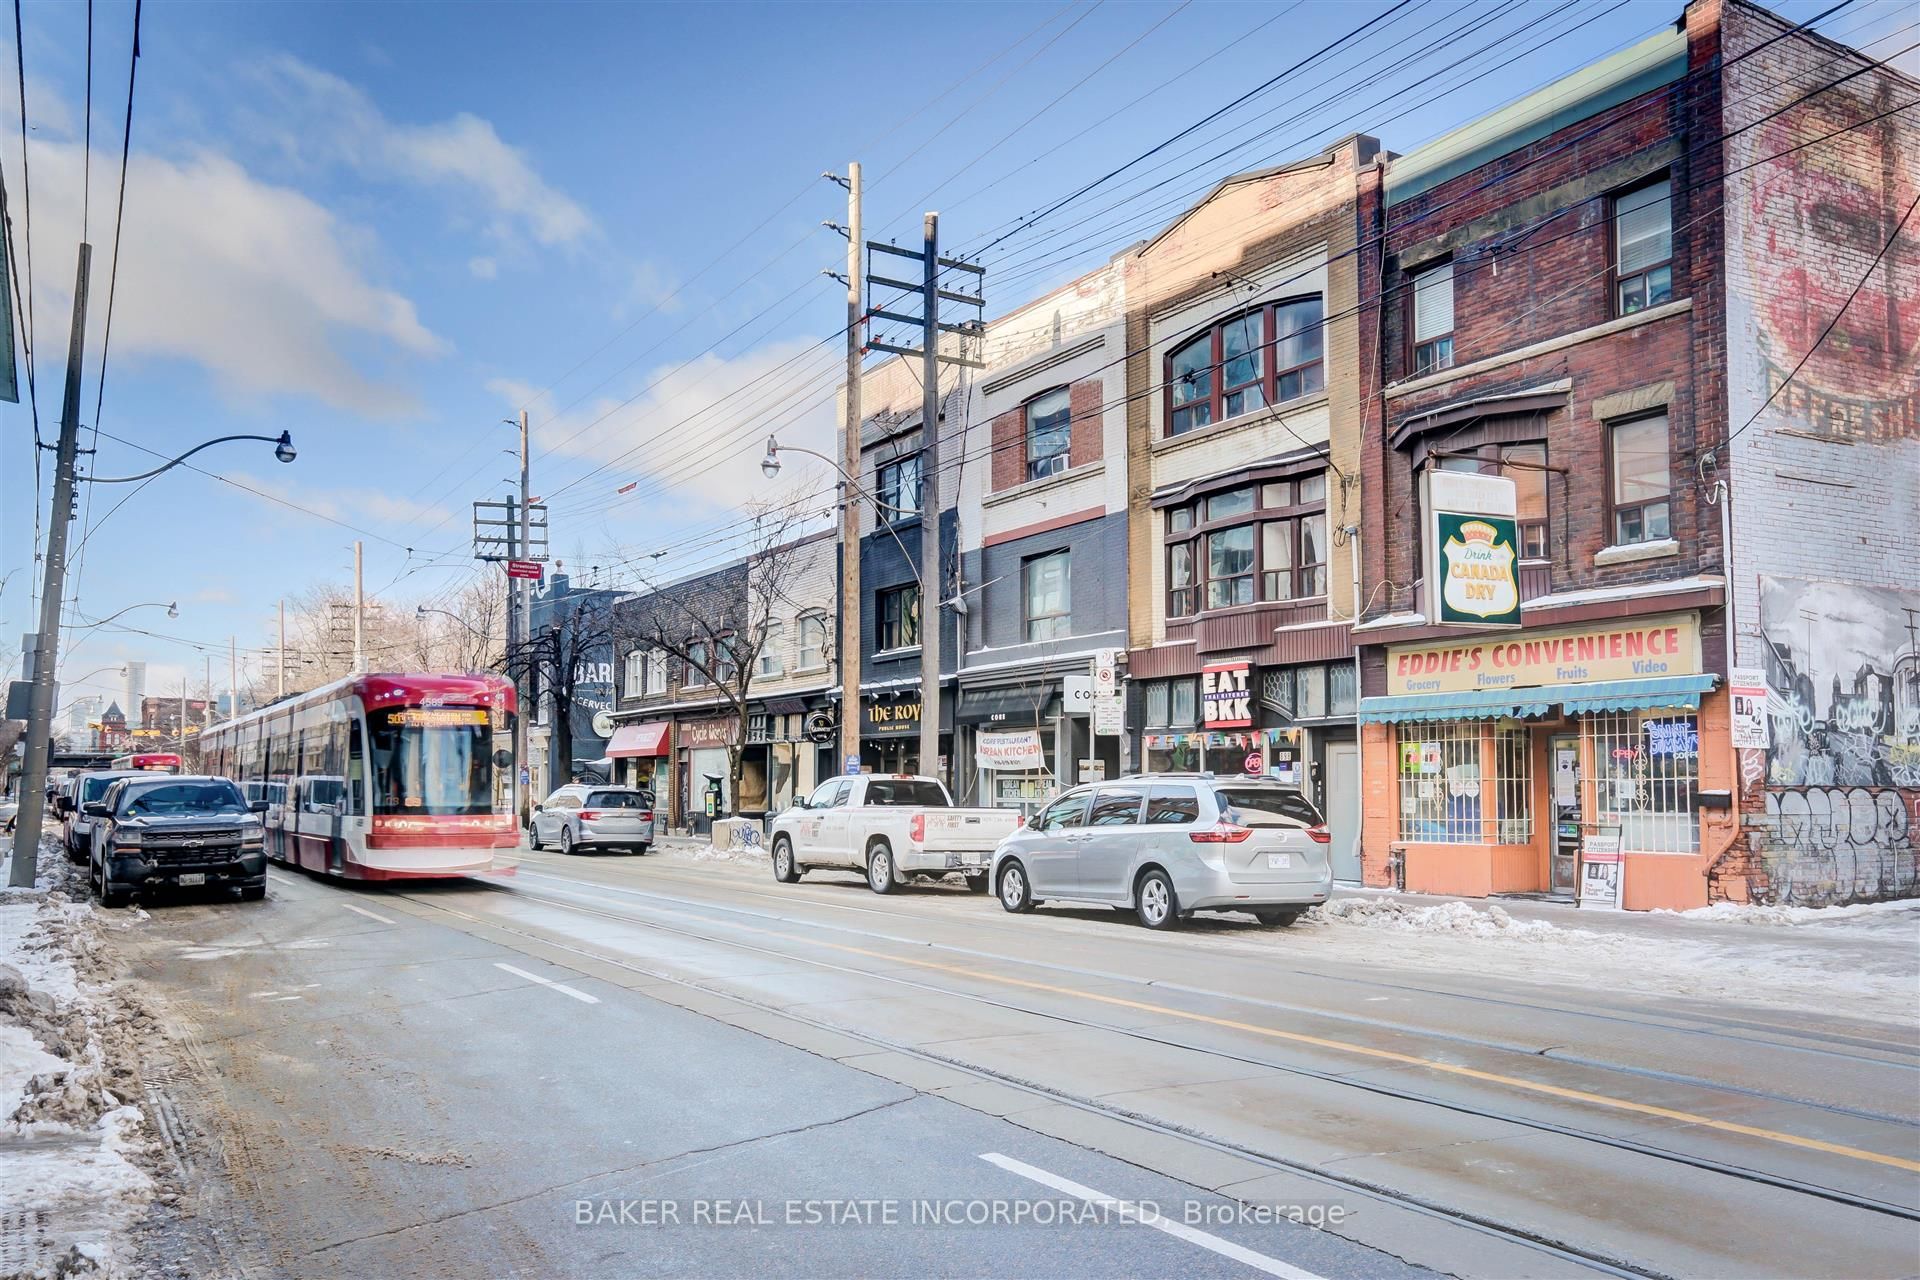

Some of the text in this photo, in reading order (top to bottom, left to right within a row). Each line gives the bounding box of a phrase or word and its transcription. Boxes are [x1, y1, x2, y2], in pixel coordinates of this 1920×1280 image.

[1464, 548, 1492, 561] Drink
[1450, 562, 1508, 582] CANADA
[1465, 583, 1496, 601] DRY
[1397, 628, 1679, 676] EDDIE'S CONVENIENCE
[1202, 669, 1250, 694] EAT
[1406, 659, 1668, 692] Grocery Flowers Fruits Video
[1204, 691, 1249, 701] THAI KITCHEN
[1204, 698, 1252, 722] BKK
[691, 727, 708, 745] Cycle
[1003, 743, 1040, 757] KITCHEN
[1612, 749, 1639, 759] OPEN
